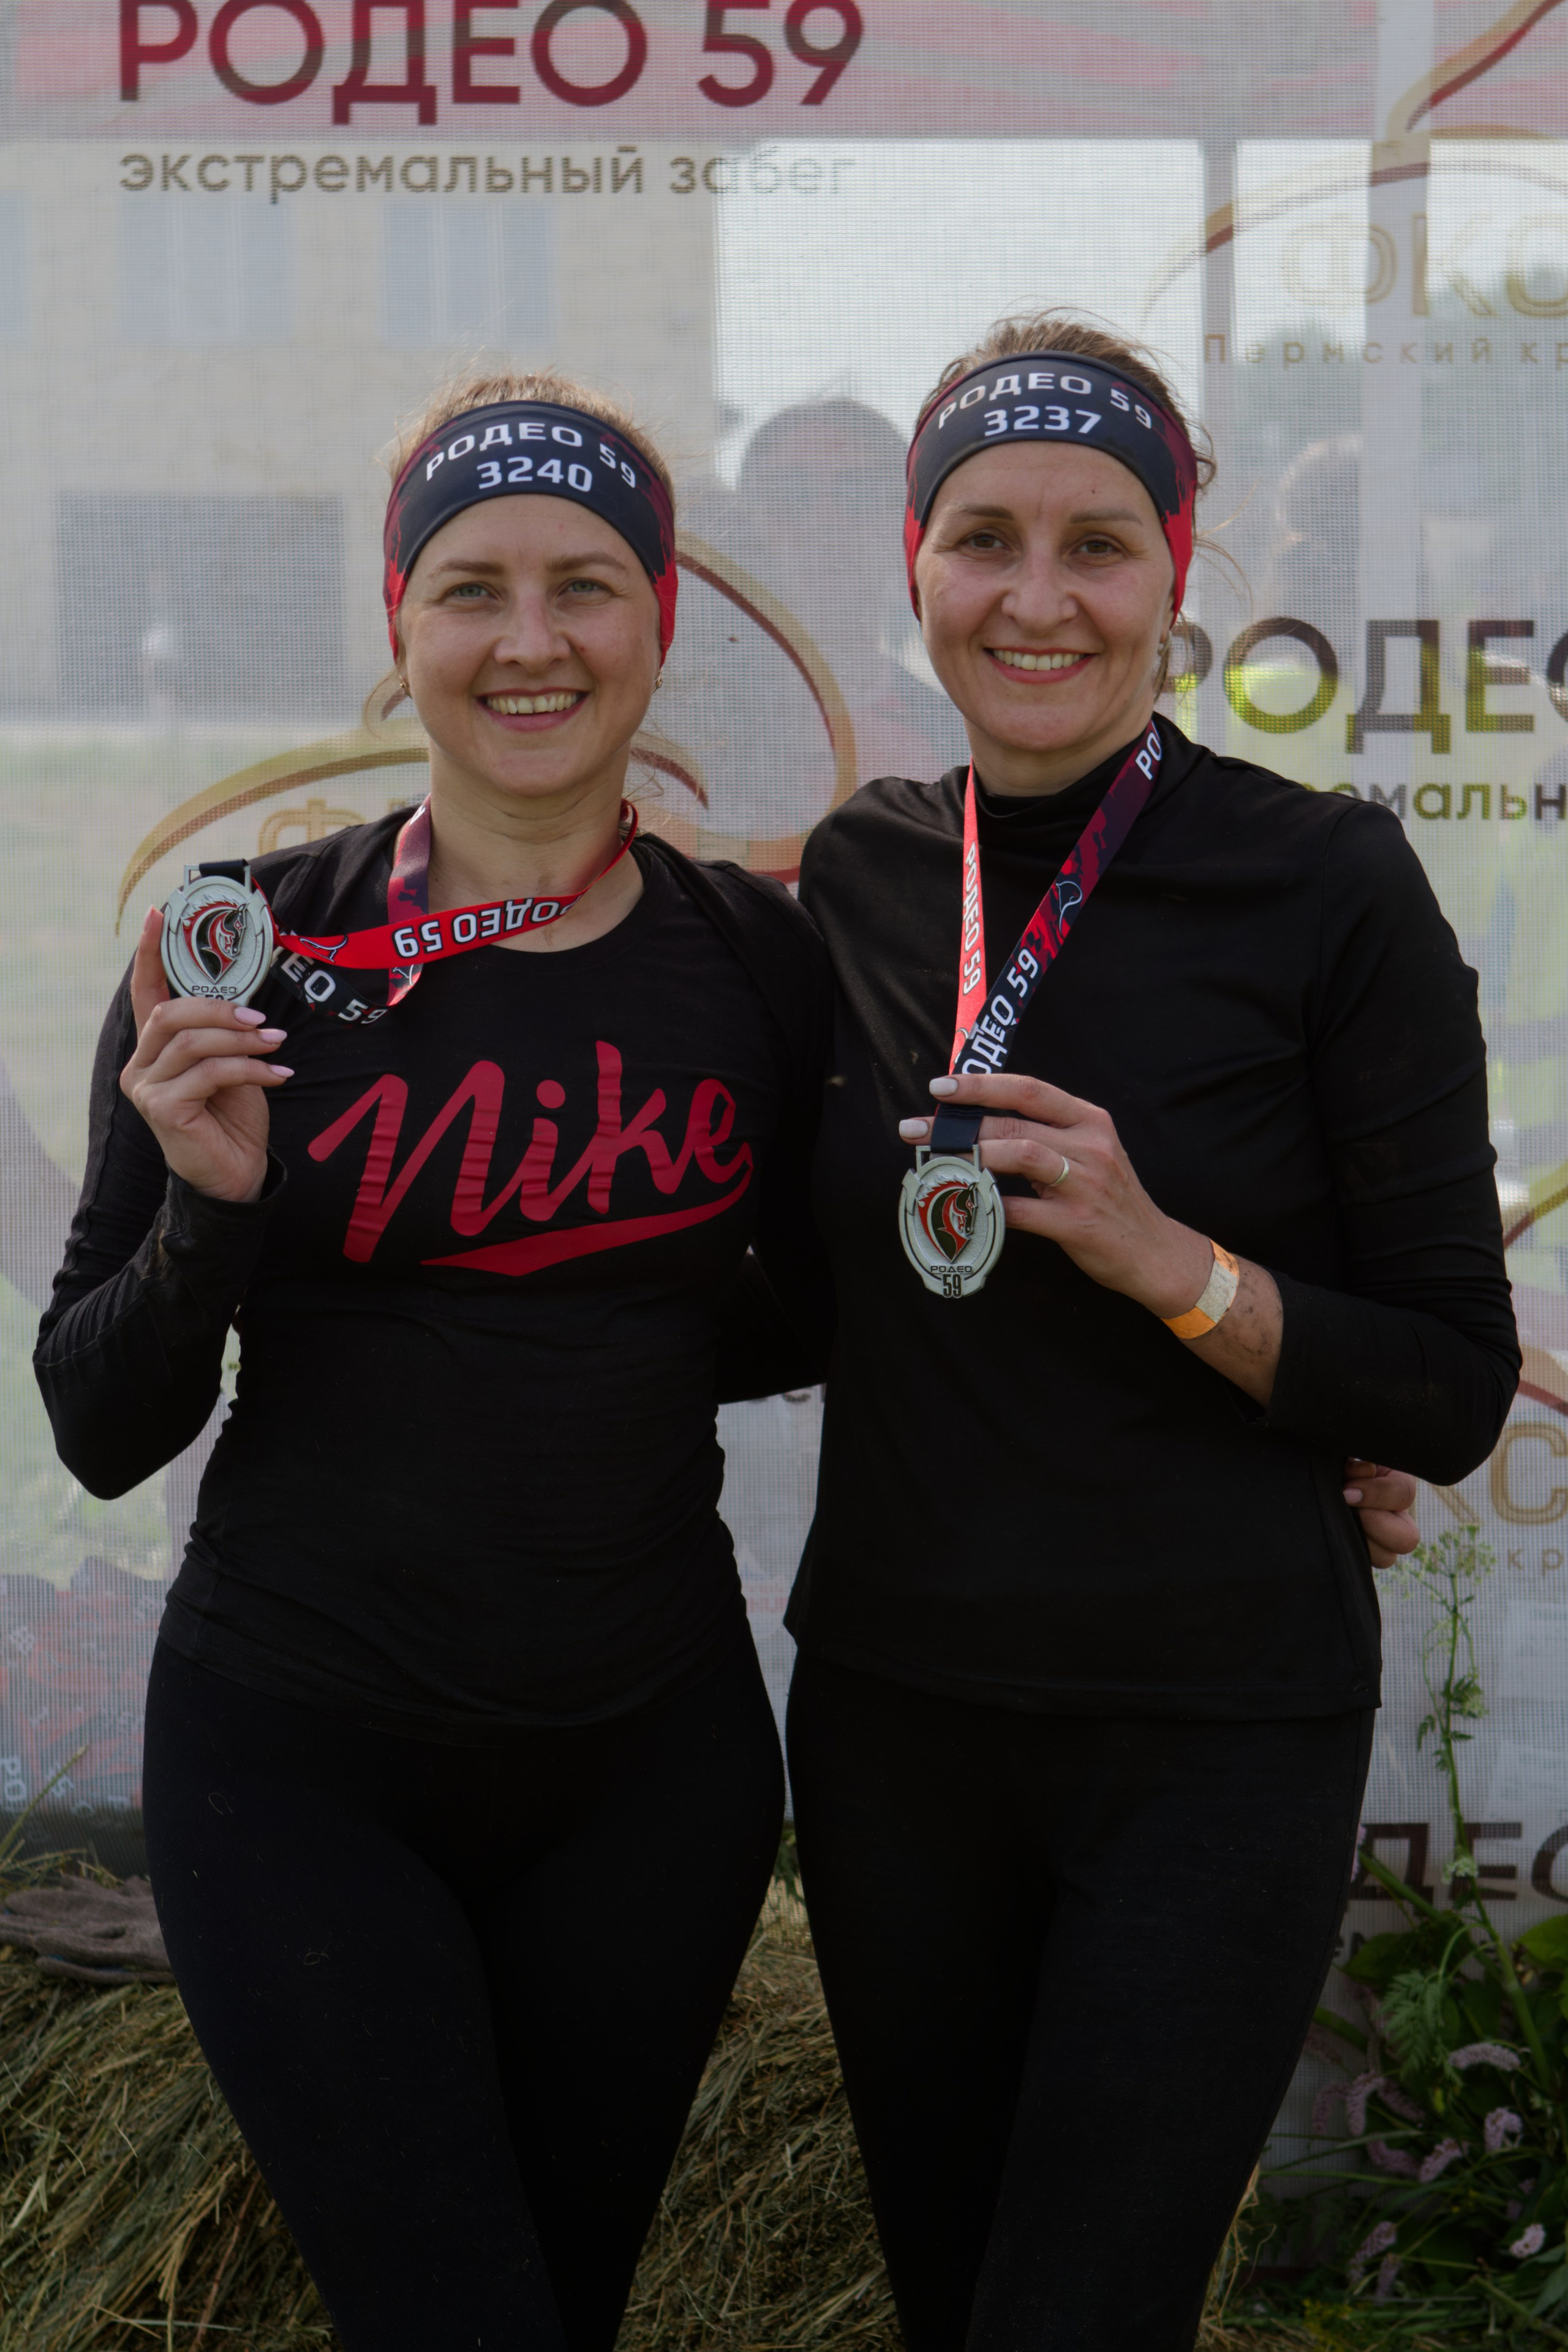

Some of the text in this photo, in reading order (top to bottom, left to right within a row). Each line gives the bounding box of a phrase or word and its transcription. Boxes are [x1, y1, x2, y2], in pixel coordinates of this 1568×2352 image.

[119, 0, 865, 126] РОДЕО 59
[119, 146, 856, 206] экстремальный забег
[938, 372, 1153, 430] РОДЕО 59
[984, 405, 1102, 437] 3237
[426, 422, 636, 489] РОДЕО 59
[477, 456, 593, 493] 3240
[1155, 617, 1568, 755] РОДЕ
[393, 919, 443, 958] 59
[963, 841, 982, 995] РОДЕО 59
[191, 984, 237, 994] РОДЕО
[337, 998, 389, 1025] 59
[961, 948, 1039, 1074] ОДЕО 59
[942, 1273, 962, 1298] 59
